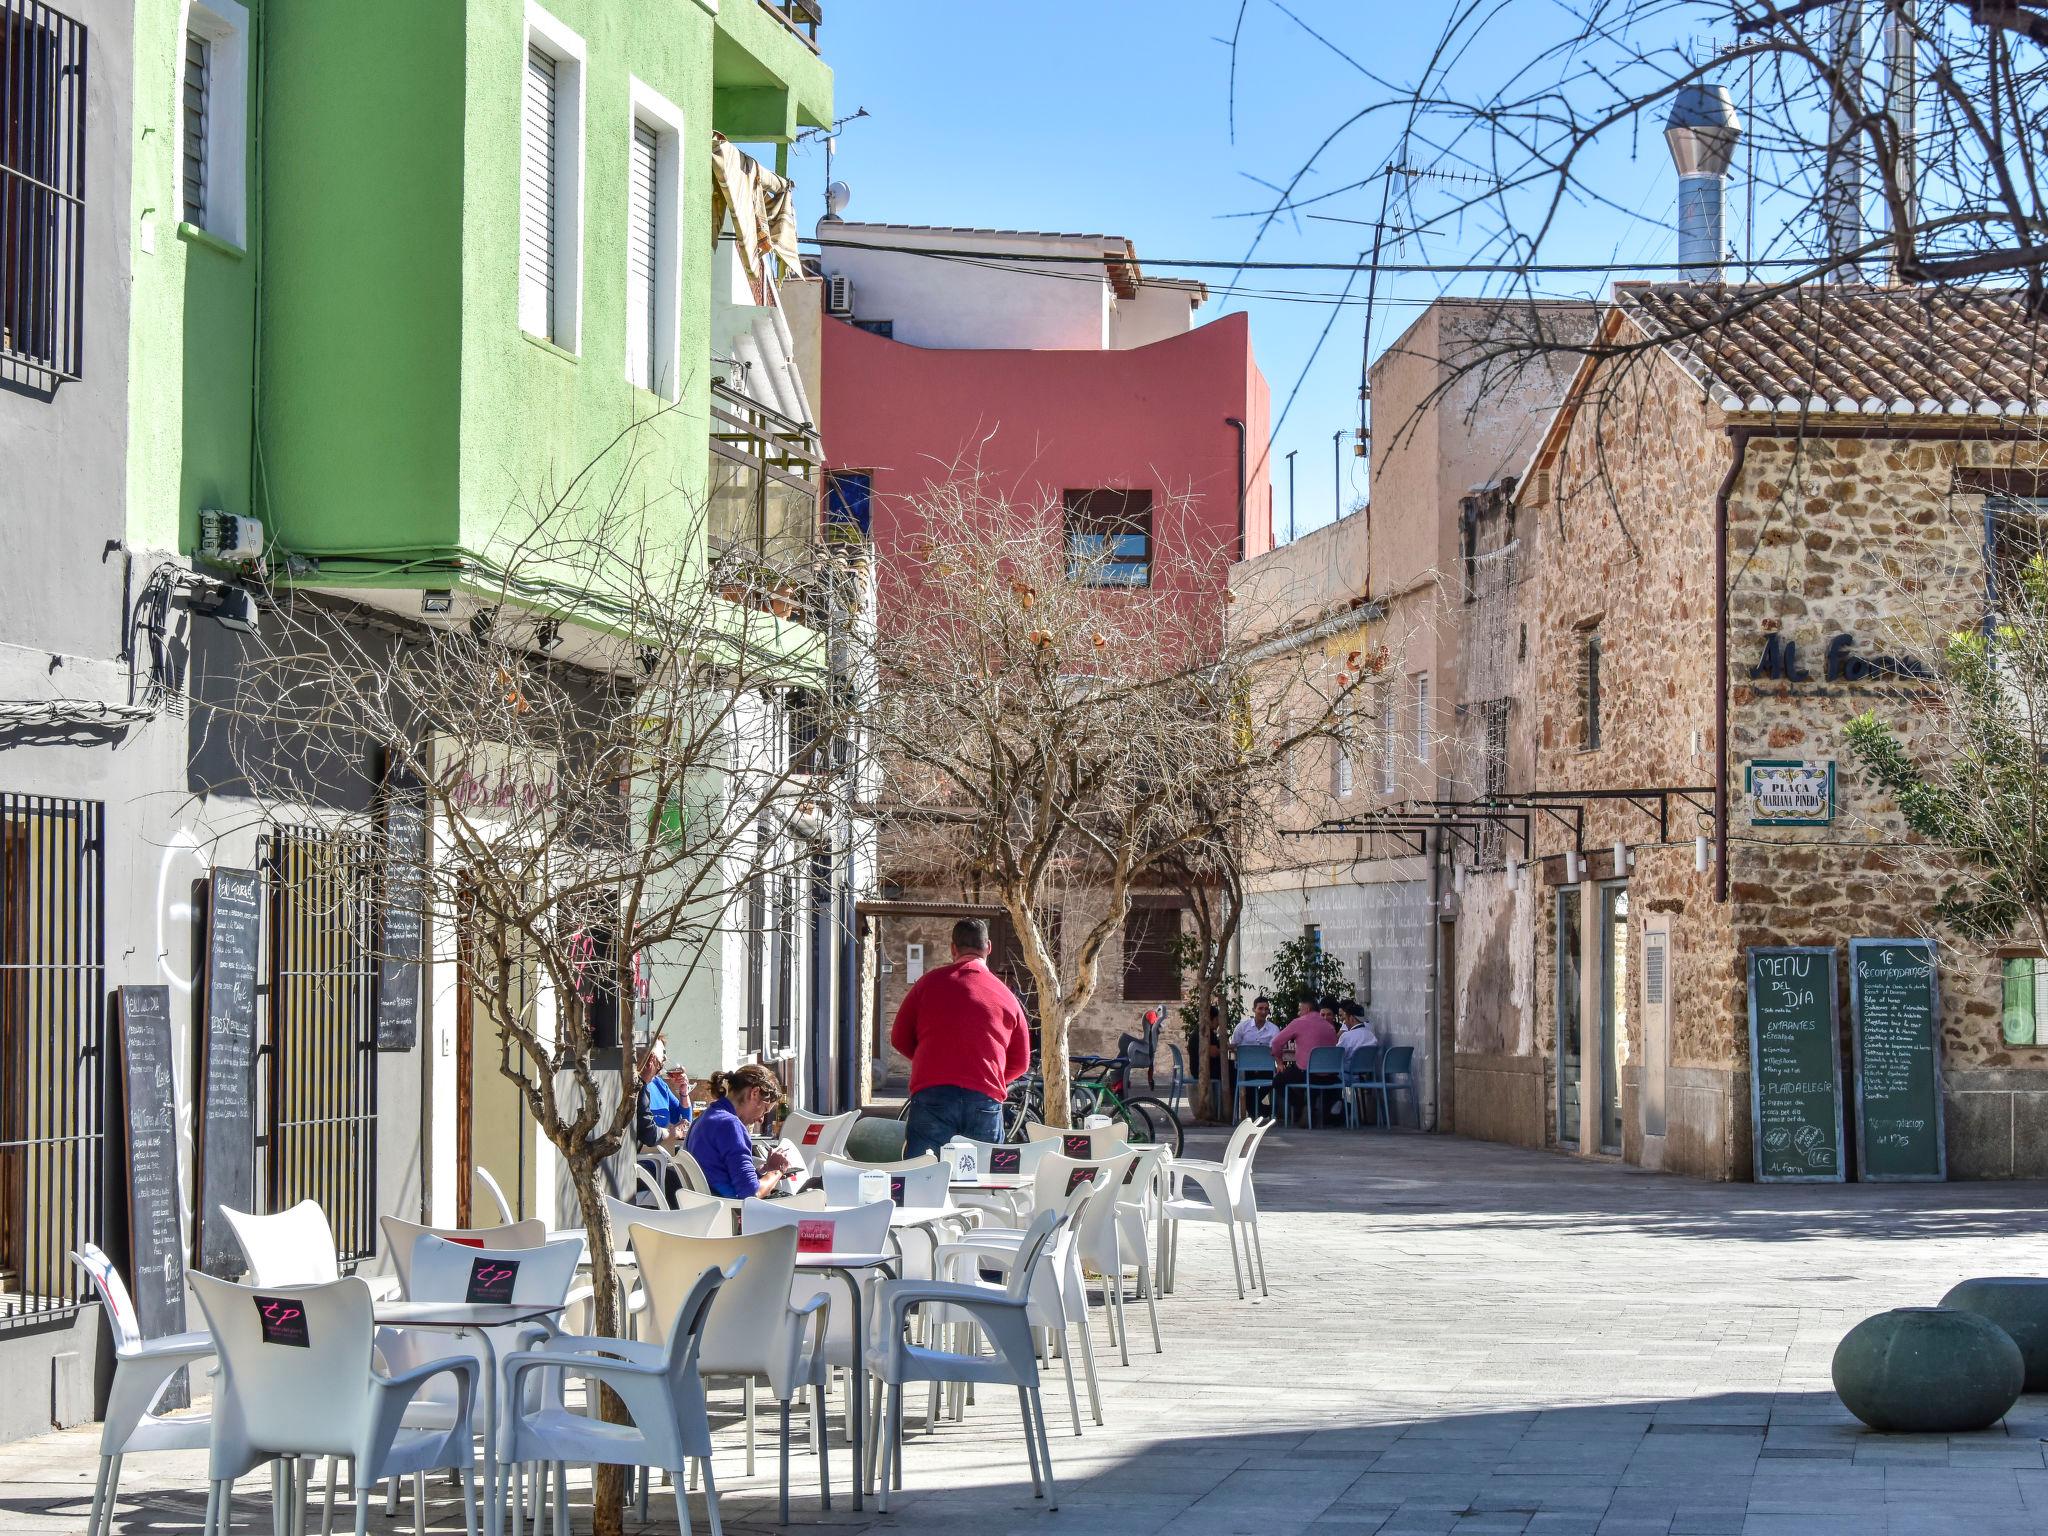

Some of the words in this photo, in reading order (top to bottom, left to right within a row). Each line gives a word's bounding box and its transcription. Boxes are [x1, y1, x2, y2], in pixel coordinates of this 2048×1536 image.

[1749, 633, 1809, 682] Al
[1772, 783, 1810, 794] PLAÇA
[1763, 795, 1793, 807] MARIANA
[1795, 795, 1819, 807] PINEDA
[1880, 949, 1895, 965] TE
[1758, 956, 1810, 977] MENU
[1771, 981, 1791, 991] DEL
[1782, 988, 1814, 1007] DÍA
[1768, 1020, 1815, 1031] ENTRANTES
[477, 1264, 513, 1288] tp
[262, 1302, 301, 1326] tp
